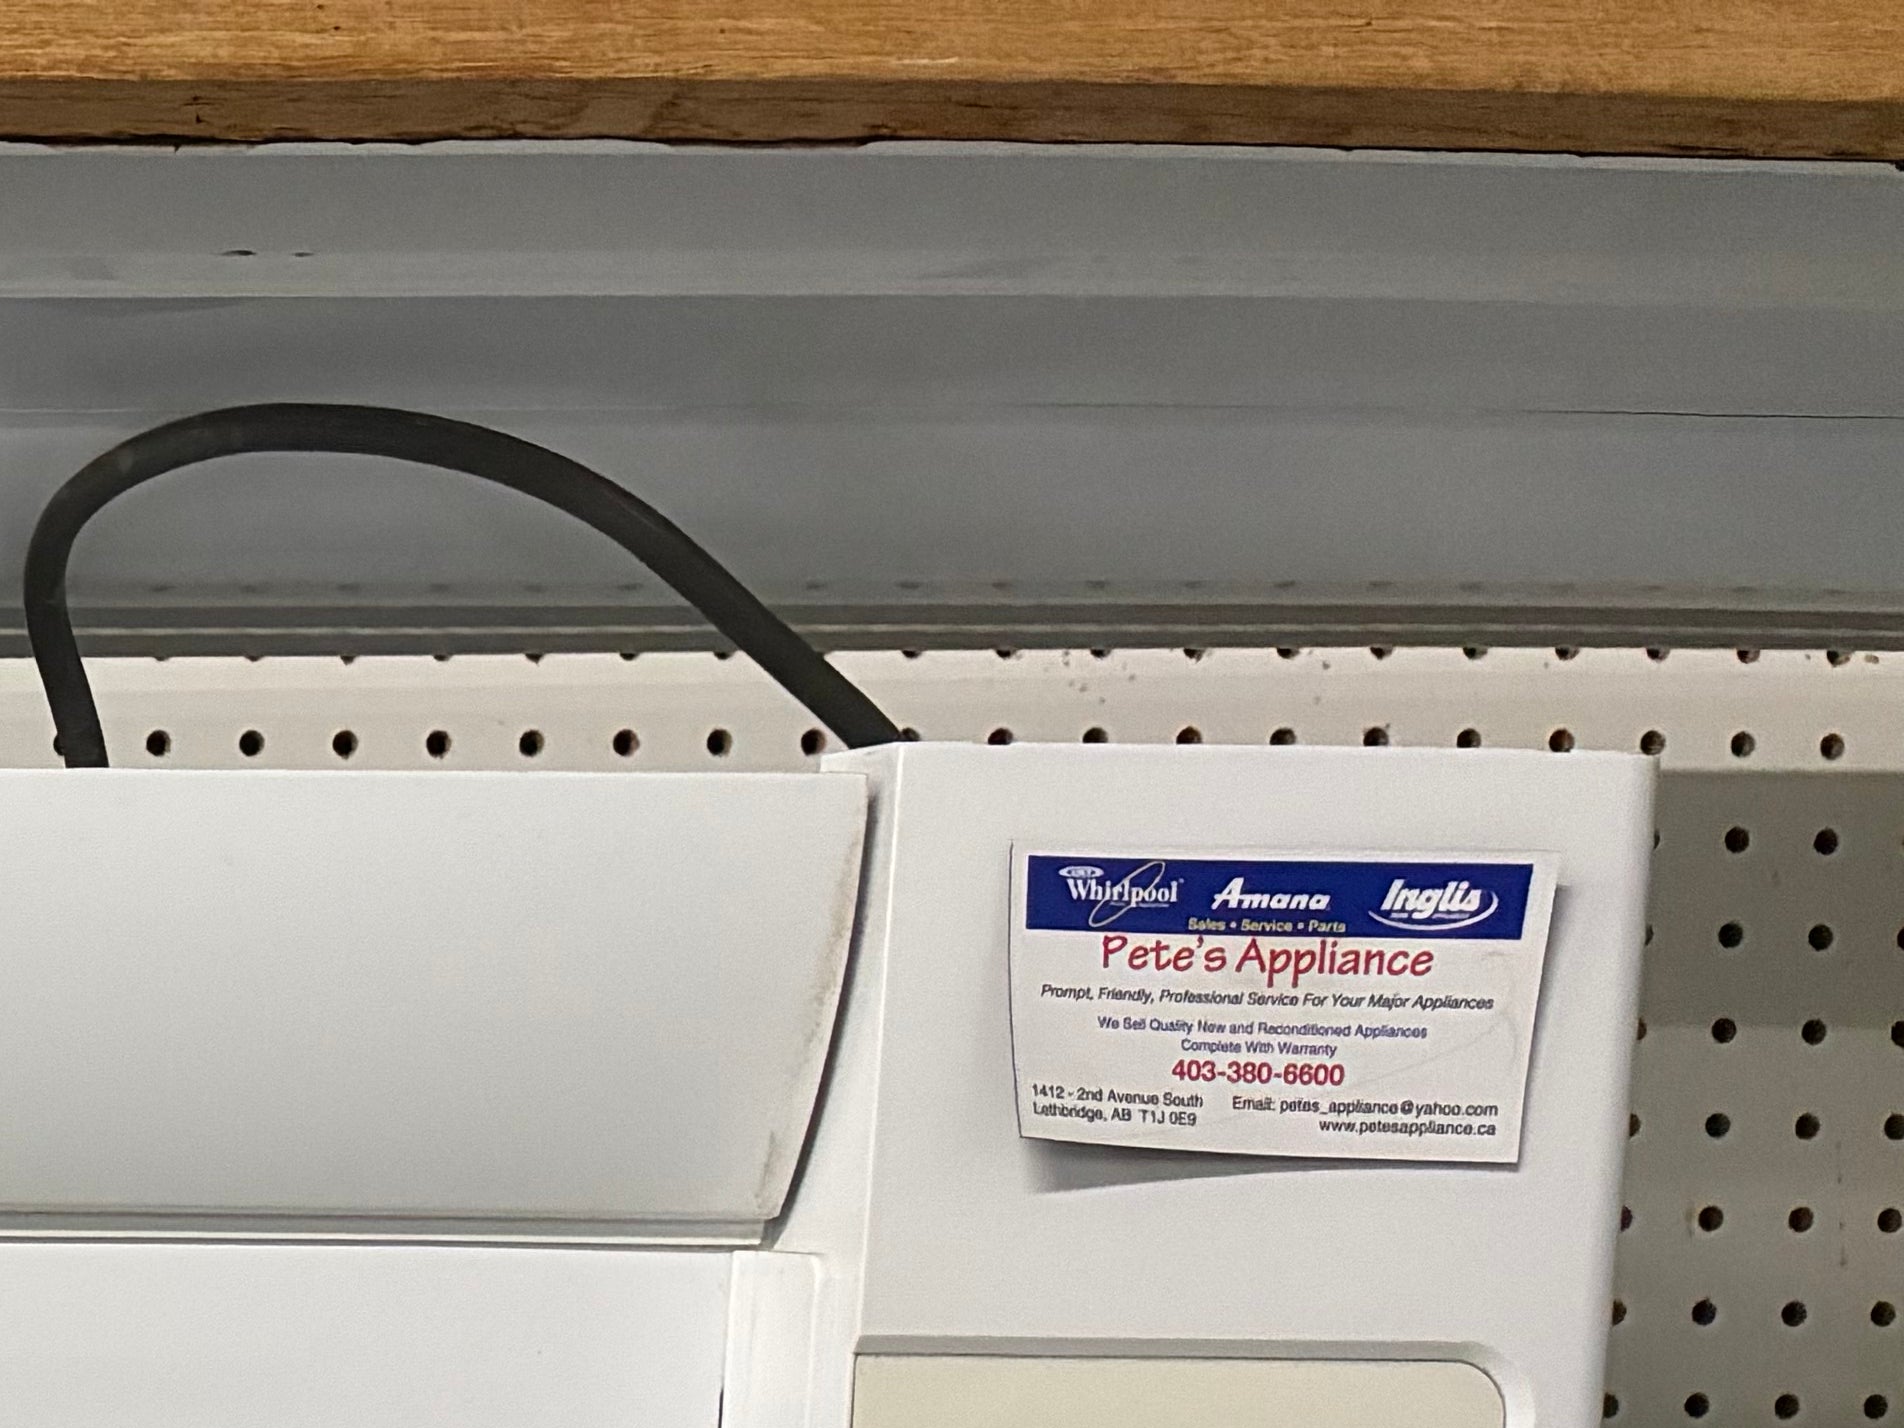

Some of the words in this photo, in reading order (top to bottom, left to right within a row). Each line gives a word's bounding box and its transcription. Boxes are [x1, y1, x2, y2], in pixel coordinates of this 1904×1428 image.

[1067, 876, 1177, 911] Whirlpool
[1211, 877, 1330, 910] Amana
[1380, 878, 1482, 919] Inglis
[1241, 919, 1293, 932] Service
[1308, 919, 1346, 932] Parts
[1103, 935, 1226, 972] Pete's
[1235, 938, 1434, 988] Appliance
[1247, 992, 1299, 1006] Service
[1303, 993, 1328, 1007] For
[1332, 993, 1366, 1007] Your
[1368, 993, 1410, 1011] Major
[1172, 1059, 1345, 1086] 403-380-6600
[1033, 1084, 1064, 1099] 1412
[1077, 1087, 1103, 1102] 2nd
[1108, 1089, 1159, 1105] Avenue
[1163, 1092, 1203, 1107] South
[1111, 1108, 1132, 1121] AB
[1138, 1109, 1165, 1124] T1J
[1169, 1111, 1197, 1126] 0E9
